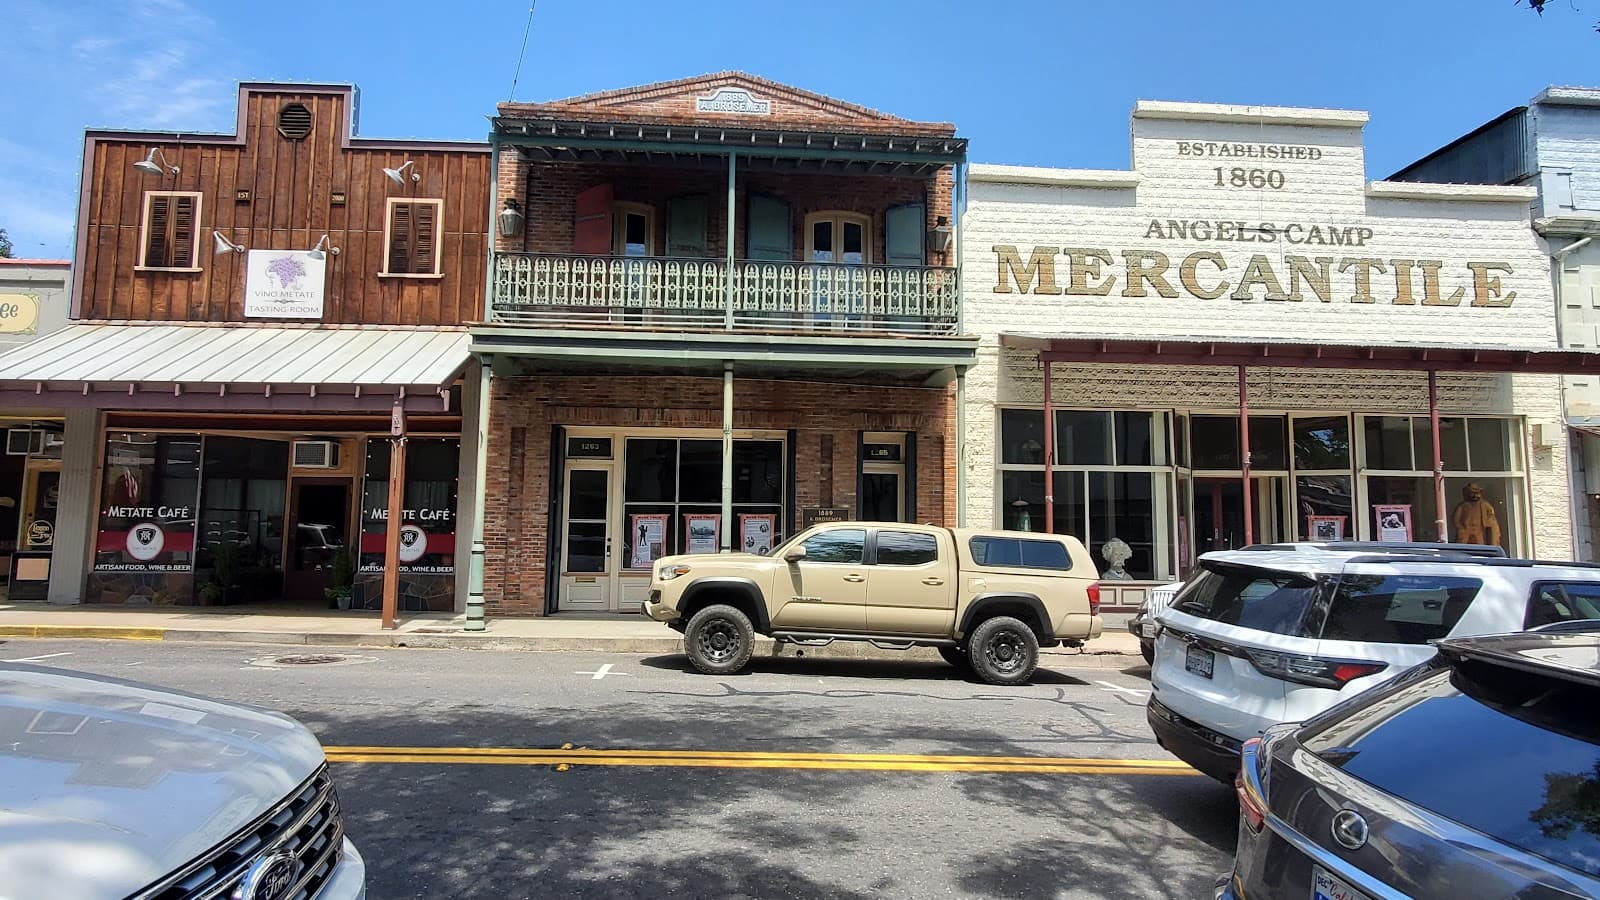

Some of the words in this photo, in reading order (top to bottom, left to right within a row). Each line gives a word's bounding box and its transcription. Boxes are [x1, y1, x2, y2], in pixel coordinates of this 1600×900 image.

[714, 102, 768, 113] BROSEMER
[1176, 142, 1322, 160] ESTABLISHED
[1214, 167, 1285, 190] 1860
[1143, 219, 1276, 243] ANGELS
[1284, 223, 1374, 247] CAMP
[991, 245, 1518, 308] MERCANTILE
[254, 290, 278, 298] VINO
[280, 290, 315, 299] METATE
[249, 305, 287, 313] TASTING
[289, 306, 319, 314] ROOM
[108, 505, 154, 518] METATE
[157, 505, 189, 518] CAFÉ
[371, 507, 416, 520] METE
[419, 507, 450, 520] CAFÉ
[265, 864, 291, 899] Ford
